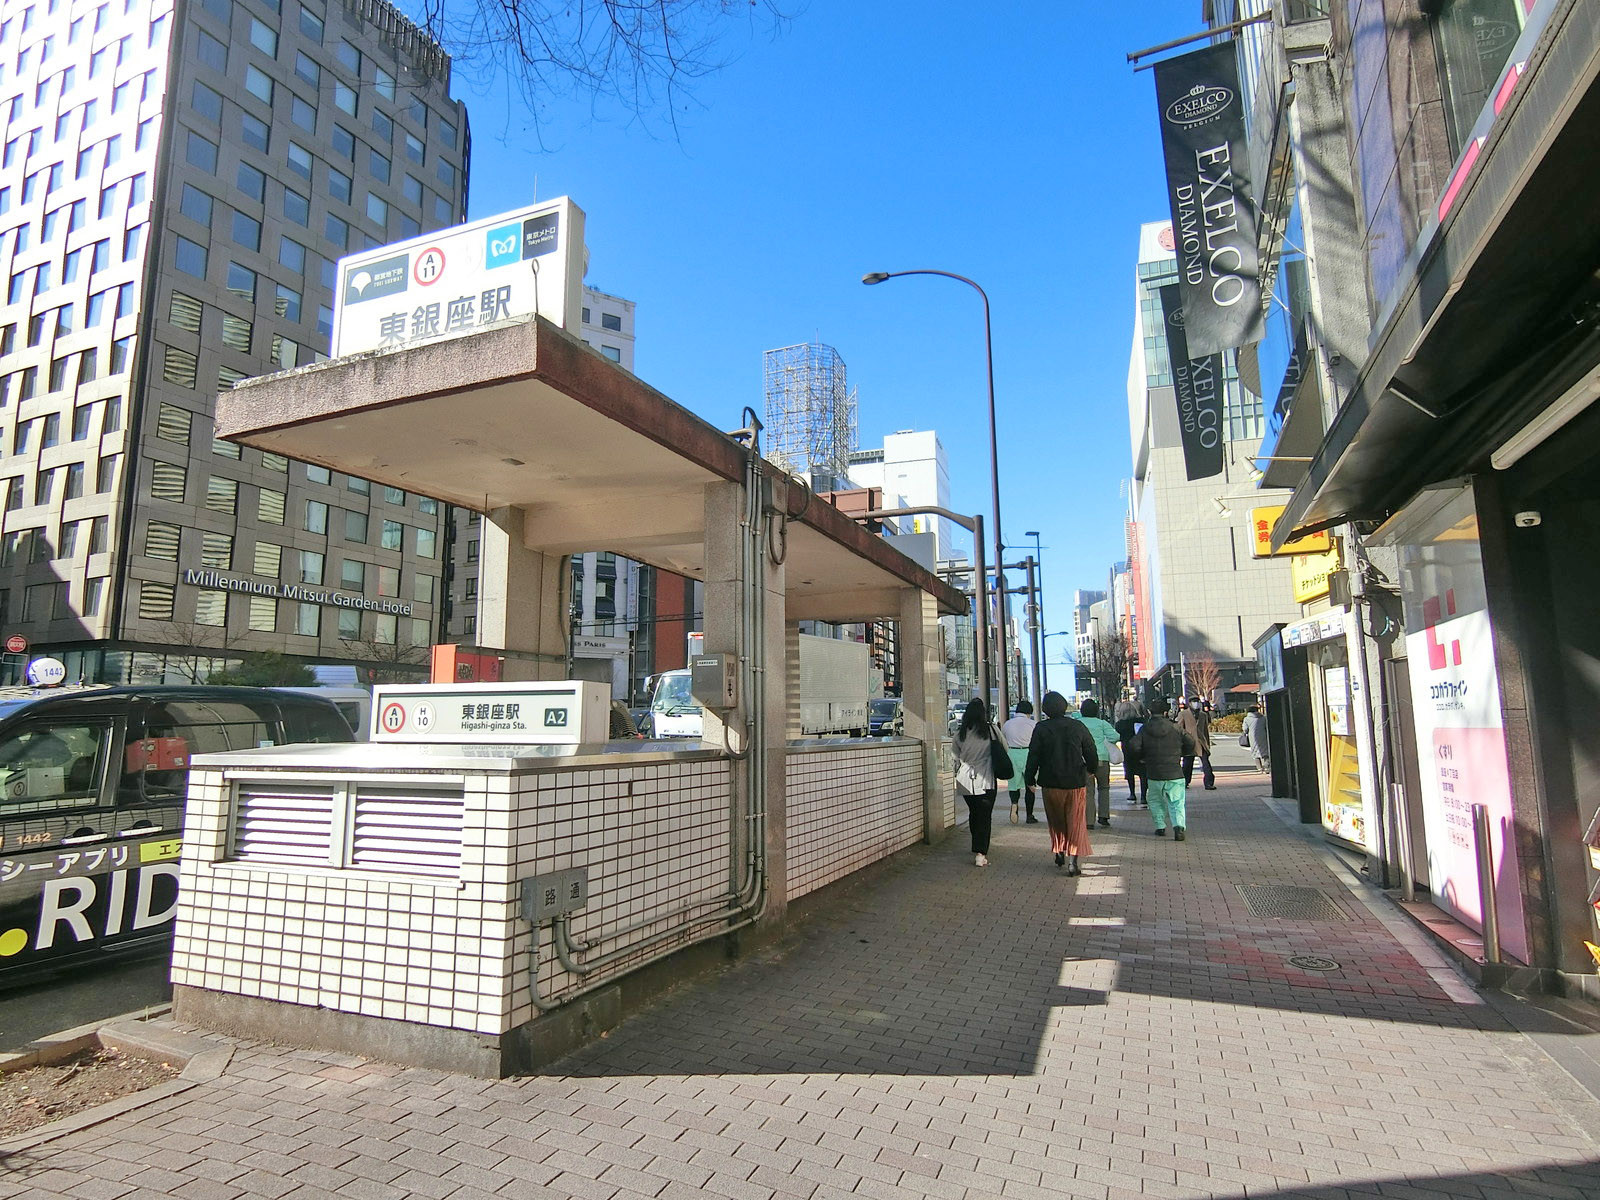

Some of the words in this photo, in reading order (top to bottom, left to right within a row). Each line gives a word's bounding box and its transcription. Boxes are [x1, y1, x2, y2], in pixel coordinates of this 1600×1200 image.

[1174, 91, 1227, 115] EXELCO
[1184, 104, 1218, 119] DIAMOND
[1195, 140, 1245, 307] EXELCO
[1176, 183, 1204, 285] DIAMOND
[425, 254, 434, 265] A
[423, 265, 436, 279] 11
[378, 285, 512, 345] 東銀座駅
[1176, 366, 1196, 433] DIAMOND
[186, 568, 277, 596] Millennium
[283, 584, 328, 603] Mitsui
[332, 592, 379, 611] Garden
[382, 600, 414, 616] Hotel
[44, 667, 63, 678] 1442
[1430, 680, 1468, 699] ココカラファイン
[391, 708, 398, 717] A
[420, 707, 427, 716] H
[461, 703, 520, 720] 東銀座駅
[545, 709, 566, 725] A2
[388, 717, 399, 727] 11
[417, 716, 429, 726] 10
[461, 721, 511, 732] Higashi-ginza
[512, 721, 527, 730] Sta.
[1439, 744, 1453, 760] くすり
[16, 832, 52, 845] 1442
[0, 845, 129, 882] シーアプリ
[34, 861, 181, 951] RID
